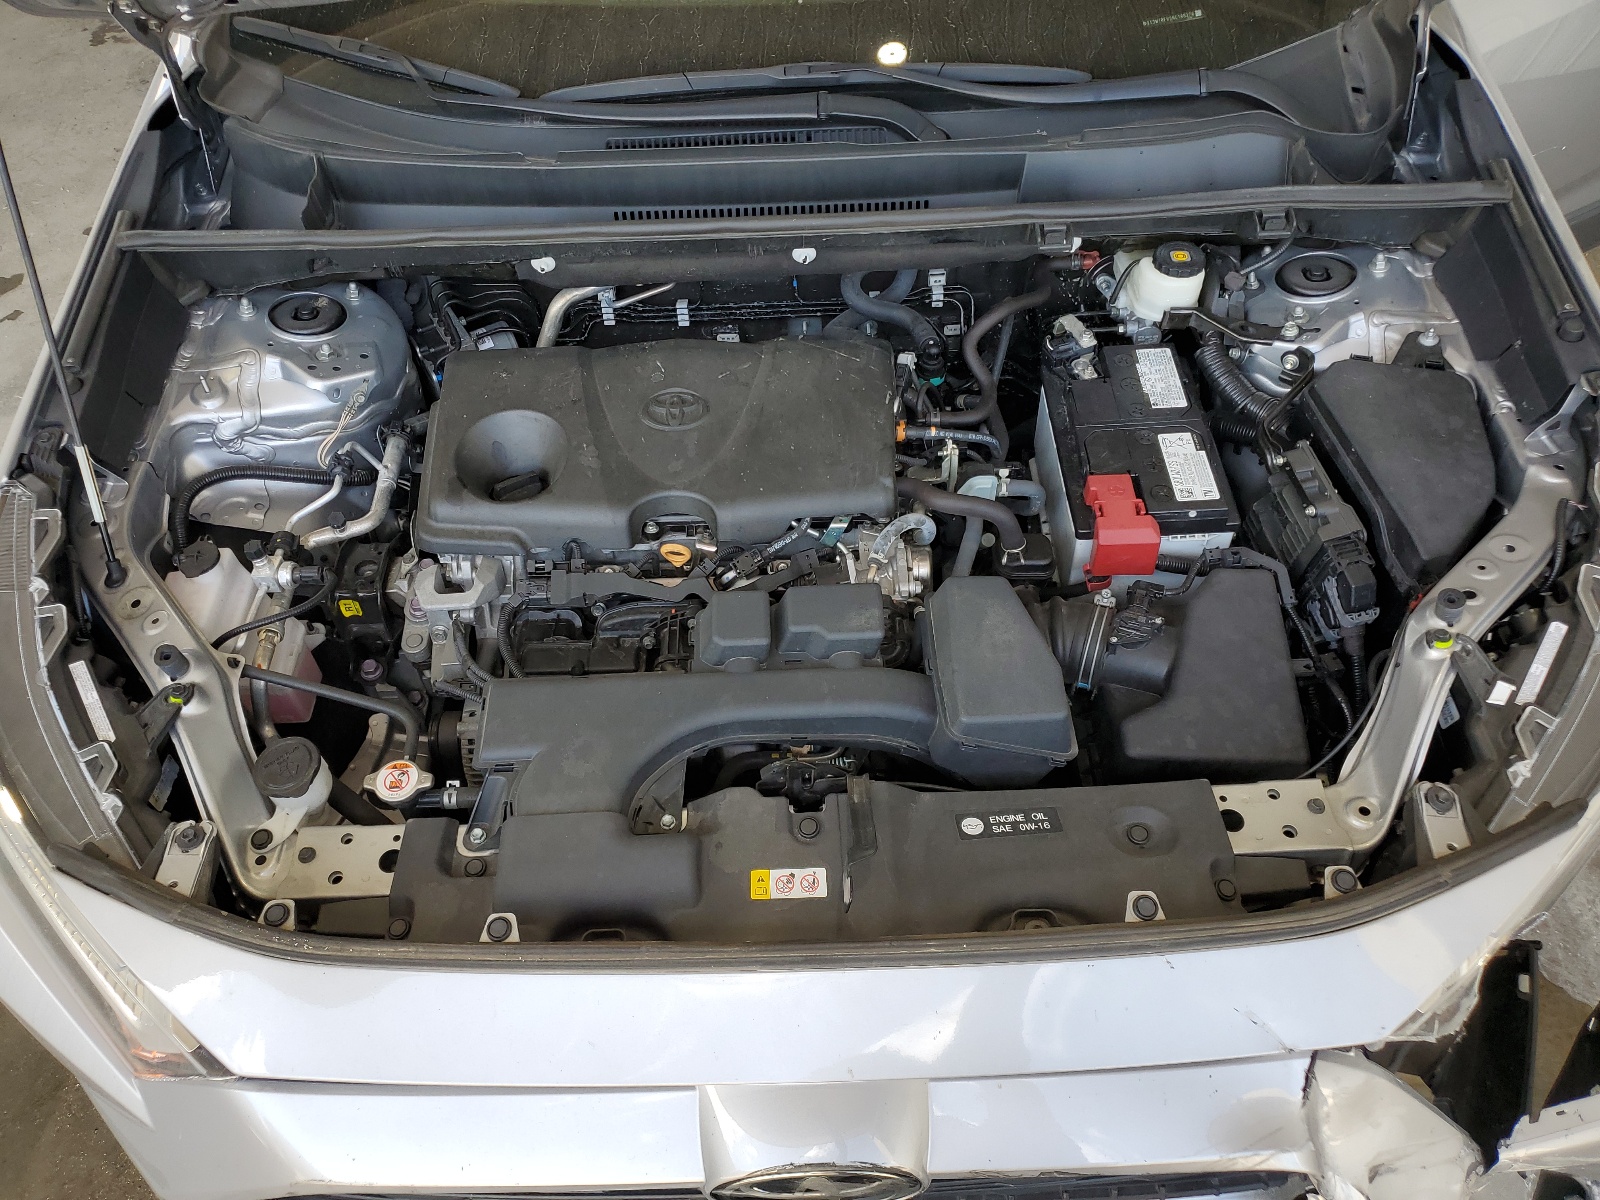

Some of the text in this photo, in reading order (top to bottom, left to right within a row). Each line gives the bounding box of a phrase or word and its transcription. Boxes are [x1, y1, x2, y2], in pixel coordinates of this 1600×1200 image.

[989, 812, 1048, 824] ENGINE OIL
[992, 821, 1051, 833] SAE 0W-16
